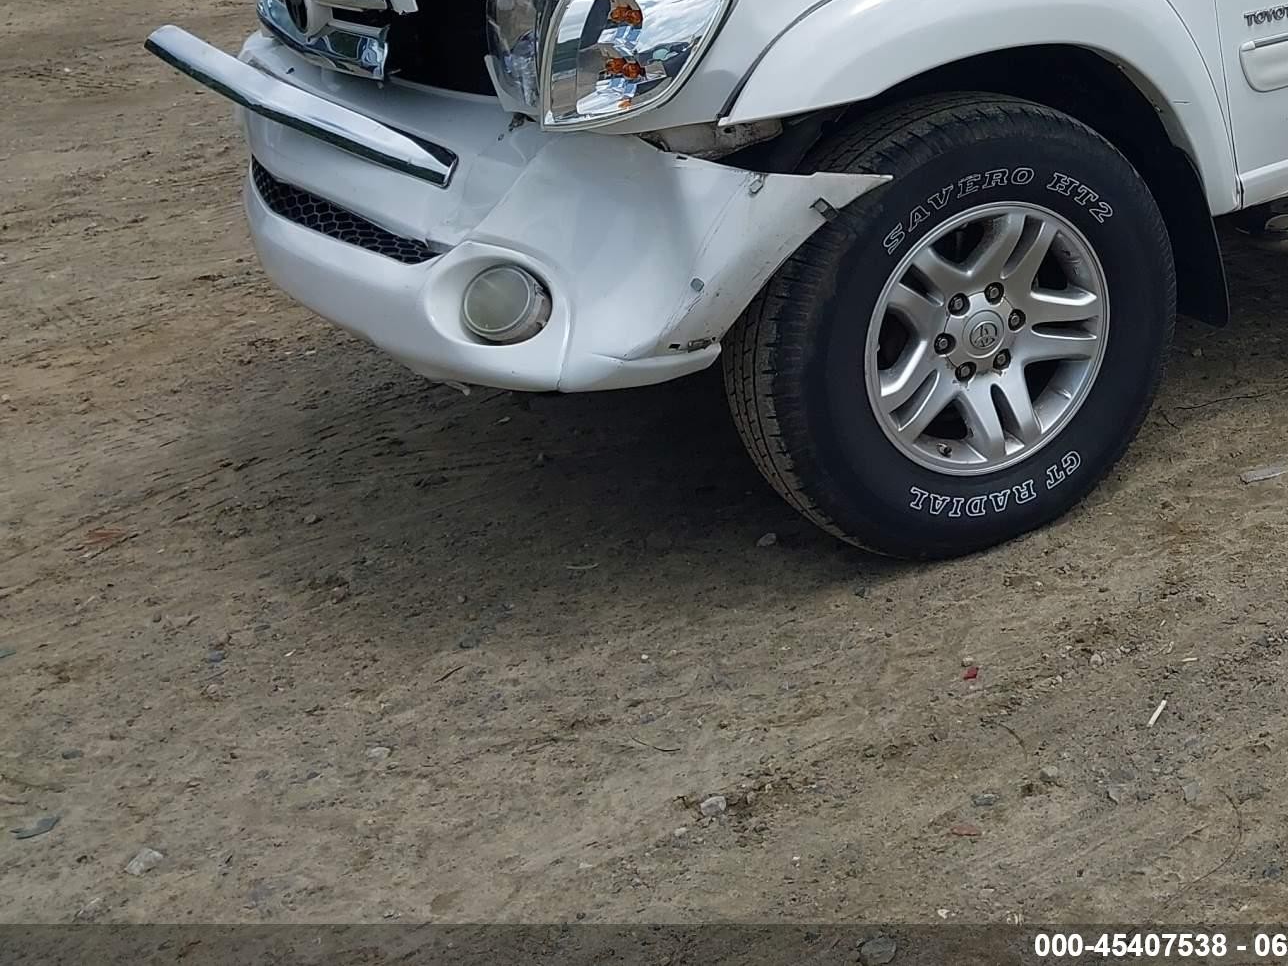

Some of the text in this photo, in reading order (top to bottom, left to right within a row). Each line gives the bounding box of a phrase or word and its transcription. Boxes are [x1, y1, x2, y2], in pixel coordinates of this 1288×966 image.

[883, 167, 1114, 256] SAVERO HT2
[910, 450, 1082, 517] GT RADIAL
